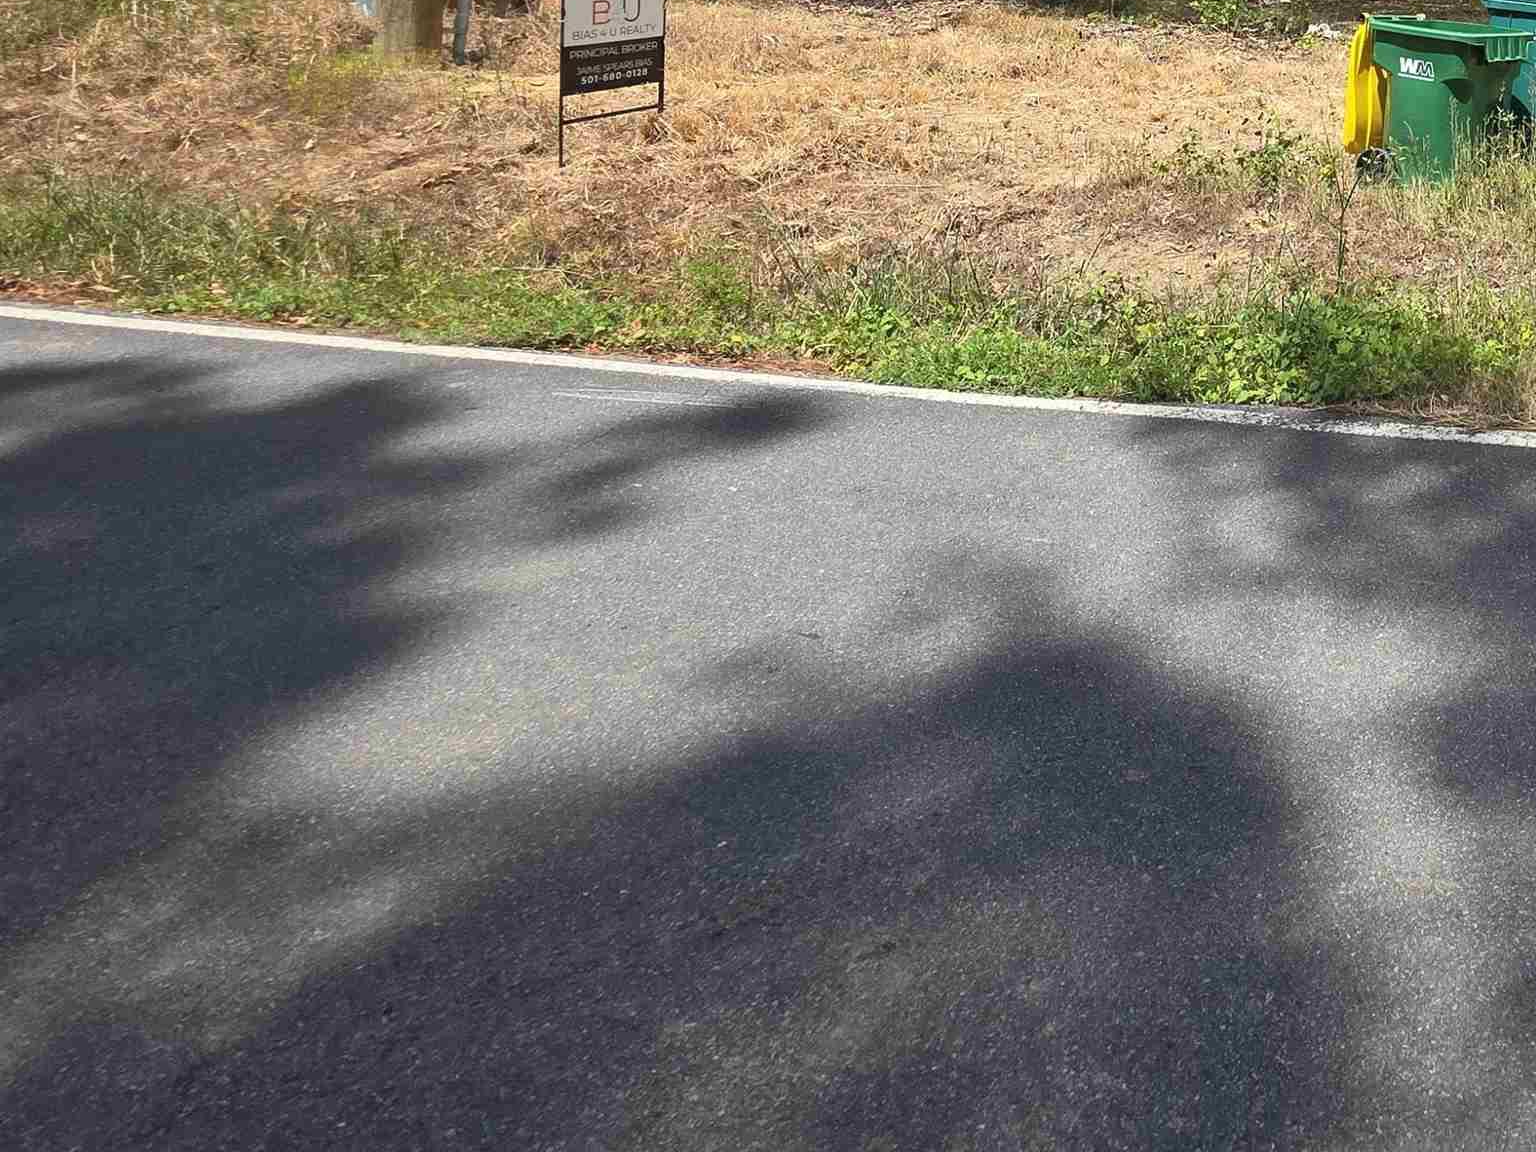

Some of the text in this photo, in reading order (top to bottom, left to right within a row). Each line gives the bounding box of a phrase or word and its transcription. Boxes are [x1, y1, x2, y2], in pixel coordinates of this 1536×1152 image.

[572, 29, 598, 41] BIAS
[619, 23, 657, 37] REALTY
[569, 41, 658, 60] PRINCIPAL BROKER
[1399, 56, 1435, 77] WM
